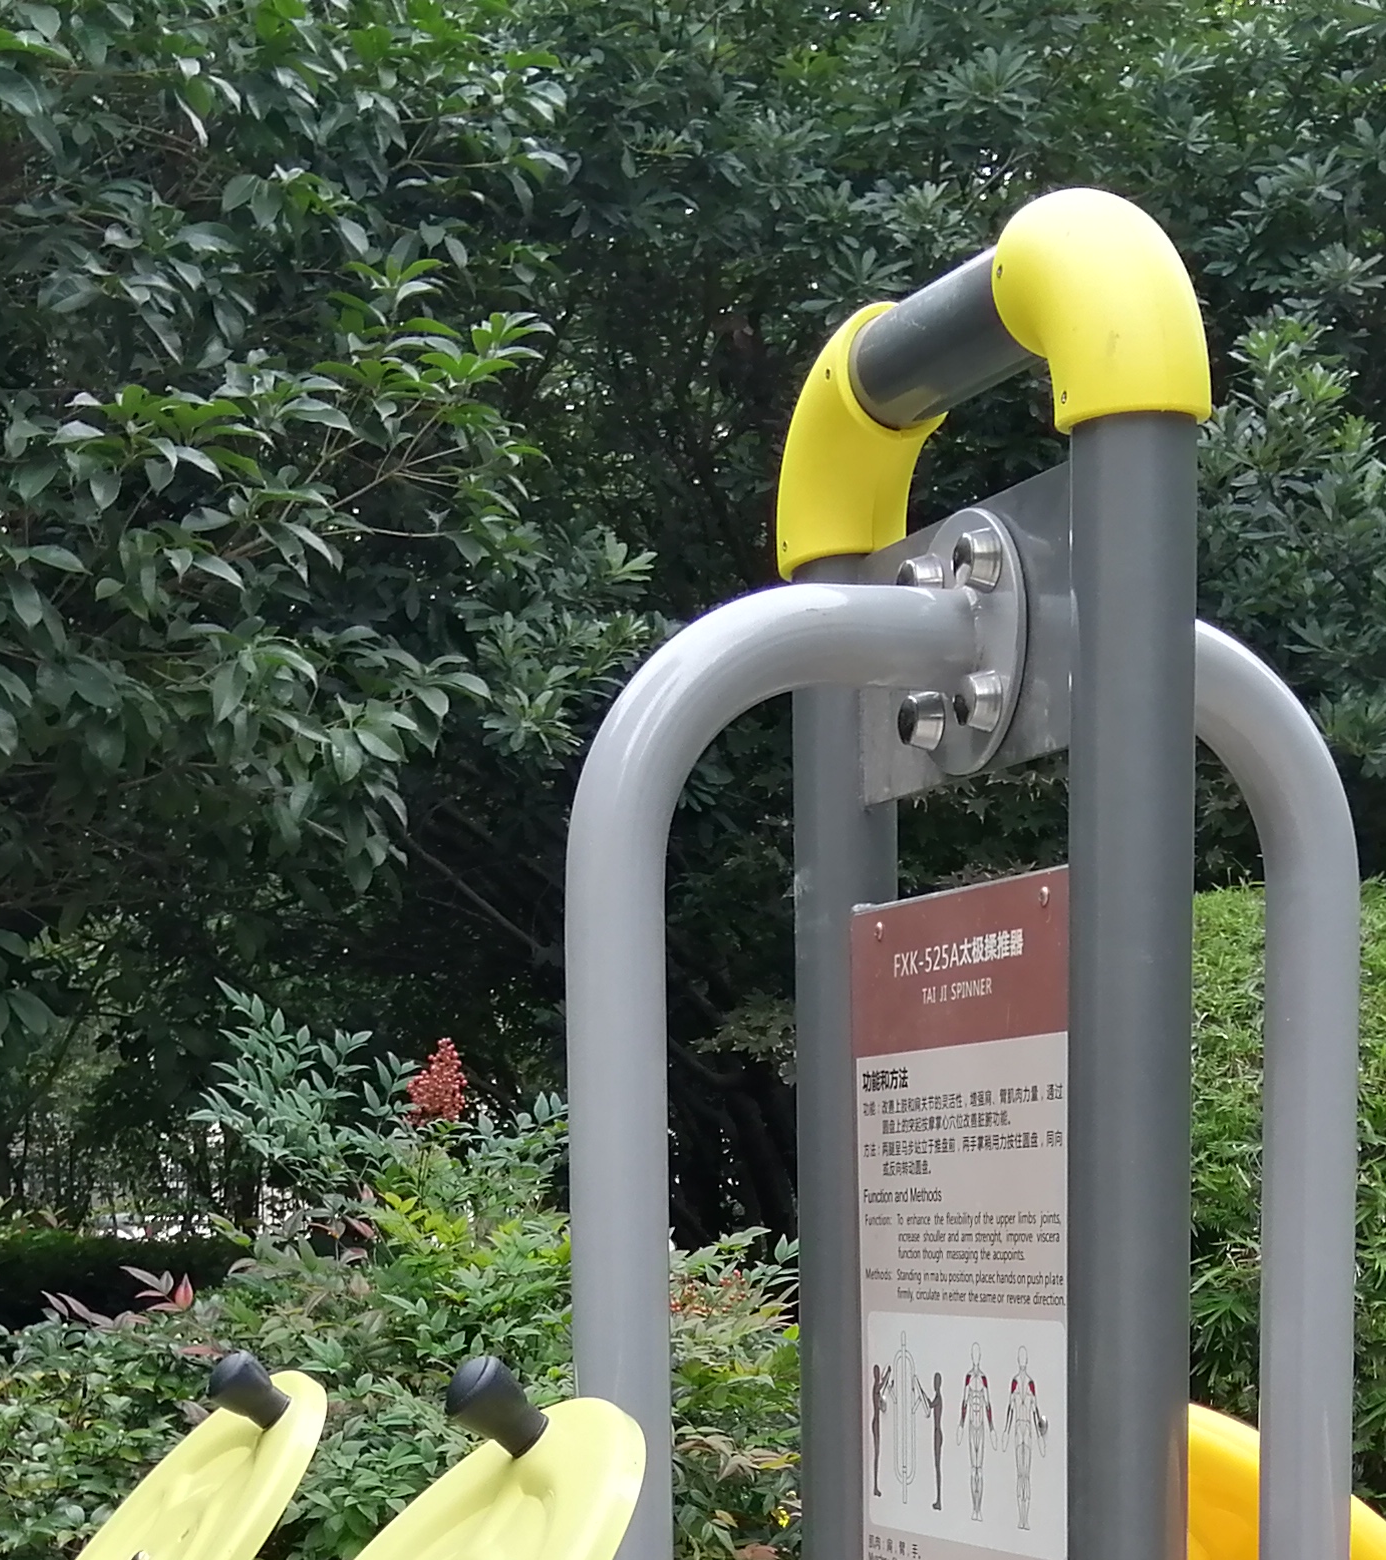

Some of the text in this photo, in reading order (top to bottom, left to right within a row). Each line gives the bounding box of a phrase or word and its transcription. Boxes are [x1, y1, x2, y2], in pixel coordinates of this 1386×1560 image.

[922, 977, 992, 1005] TAI JI SPINNER
[862, 1067, 909, 1091] 功能和方法
[863, 1187, 942, 1202] Function and Methods
[897, 1214, 904, 1224] To
[906, 1214, 931, 1224] enhance
[934, 1214, 945, 1224] the
[946, 1213, 973, 1226] flexibility
[974, 1212, 981, 1224] of
[983, 1212, 994, 1224] the
[996, 1215, 1016, 1226] upper
[1018, 1212, 1036, 1223] limbs
[1040, 1212, 1061, 1226] joints,
[947, 1231, 960, 1241] and
[961, 1233, 973, 1242] arm
[1006, 1230, 1033, 1243] improve
[1036, 1230, 1060, 1242] viscera
[898, 1248, 1025, 1263] function though massaging the acupoints.
[897, 1269, 922, 1283] Standing
[924, 1270, 929, 1280] in
[940, 1270, 948, 1281] bu
[996, 1271, 1016, 1284] hands
[1017, 1275, 1026, 1284] on
[1027, 1272, 1043, 1287] push
[1044, 1273, 1064, 1288] plate
[916, 1288, 940, 1300] circulate
[942, 1289, 948, 1300] in
[949, 1289, 967, 1301] either
[968, 1290, 979, 1301] the
[979, 1293, 996, 1302] same
[997, 1294, 1004, 1302] or
[1007, 1294, 1031, 1304] reverse
[1033, 1293, 1066, 1306] direction.
